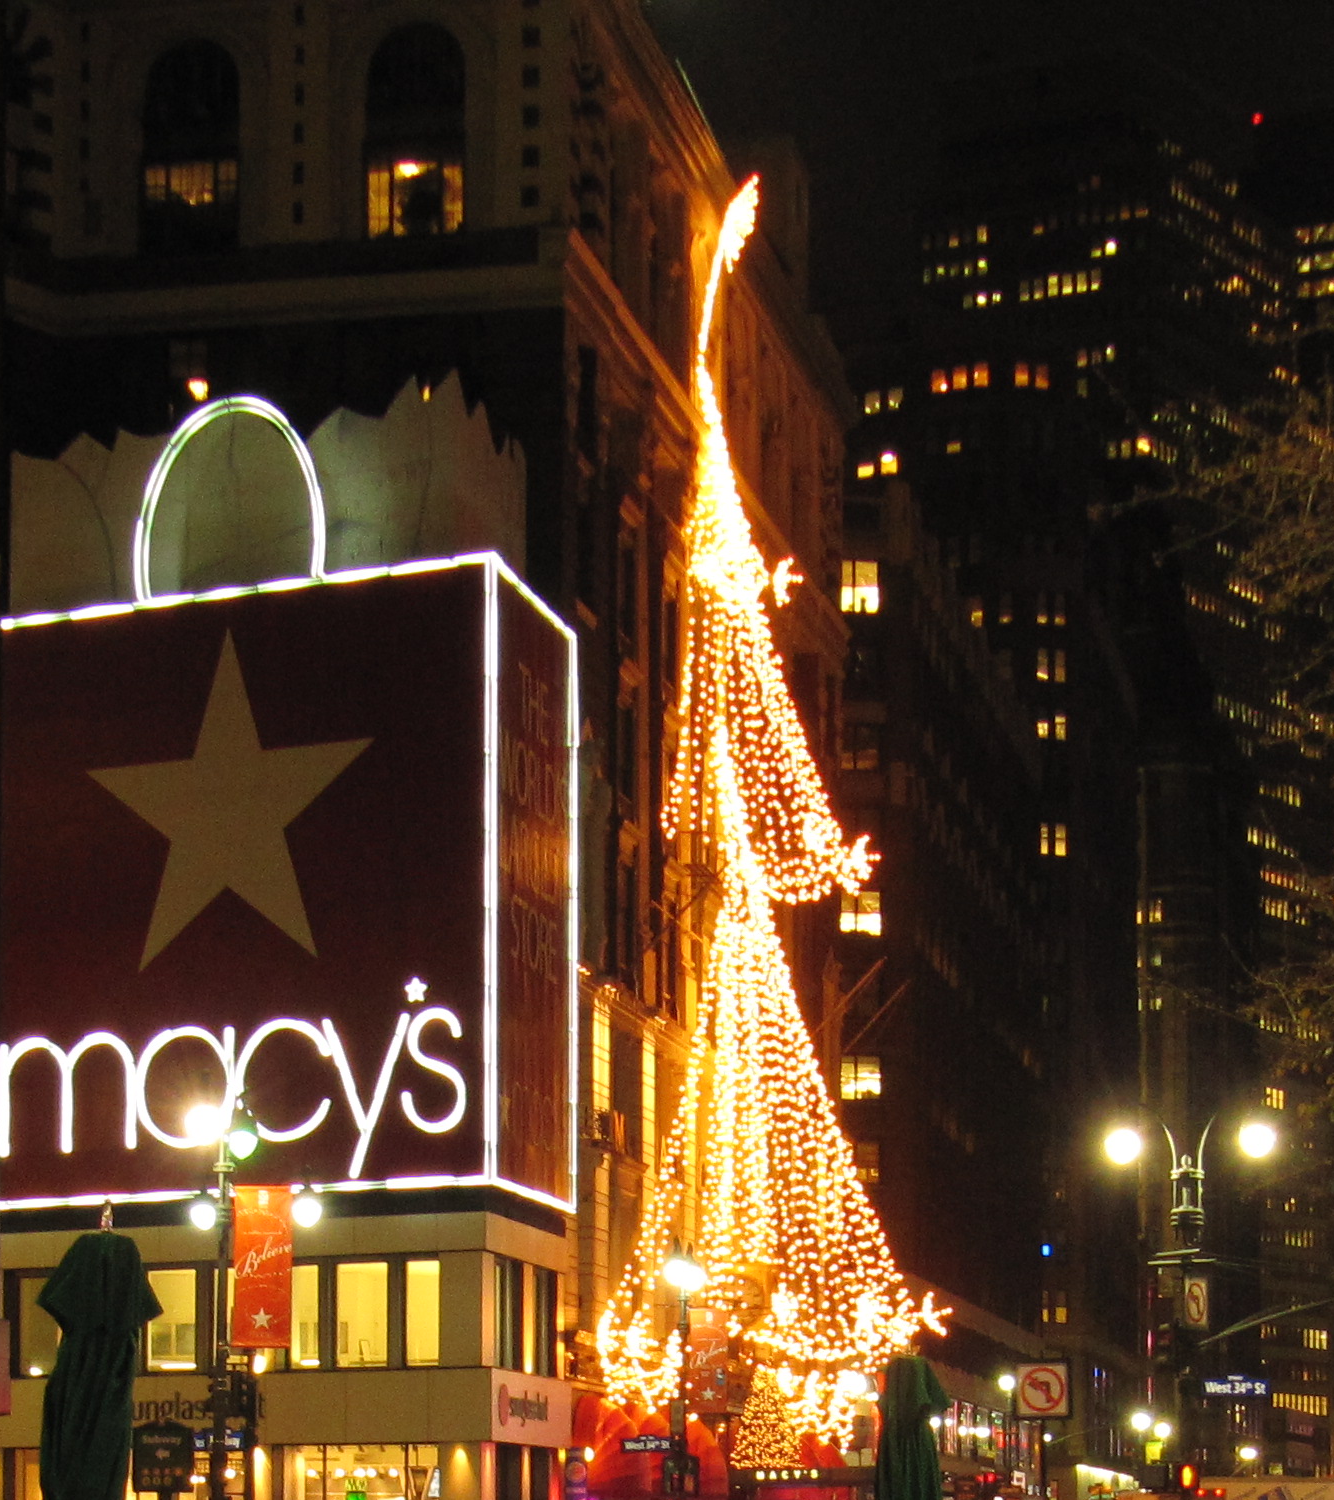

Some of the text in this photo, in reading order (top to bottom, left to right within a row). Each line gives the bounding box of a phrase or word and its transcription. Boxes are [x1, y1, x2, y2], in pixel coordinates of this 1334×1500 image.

[1204, 1381, 1232, 1394] West
[1254, 1382, 1267, 1395] St
[755, 1469, 819, 1481] MACY'S
